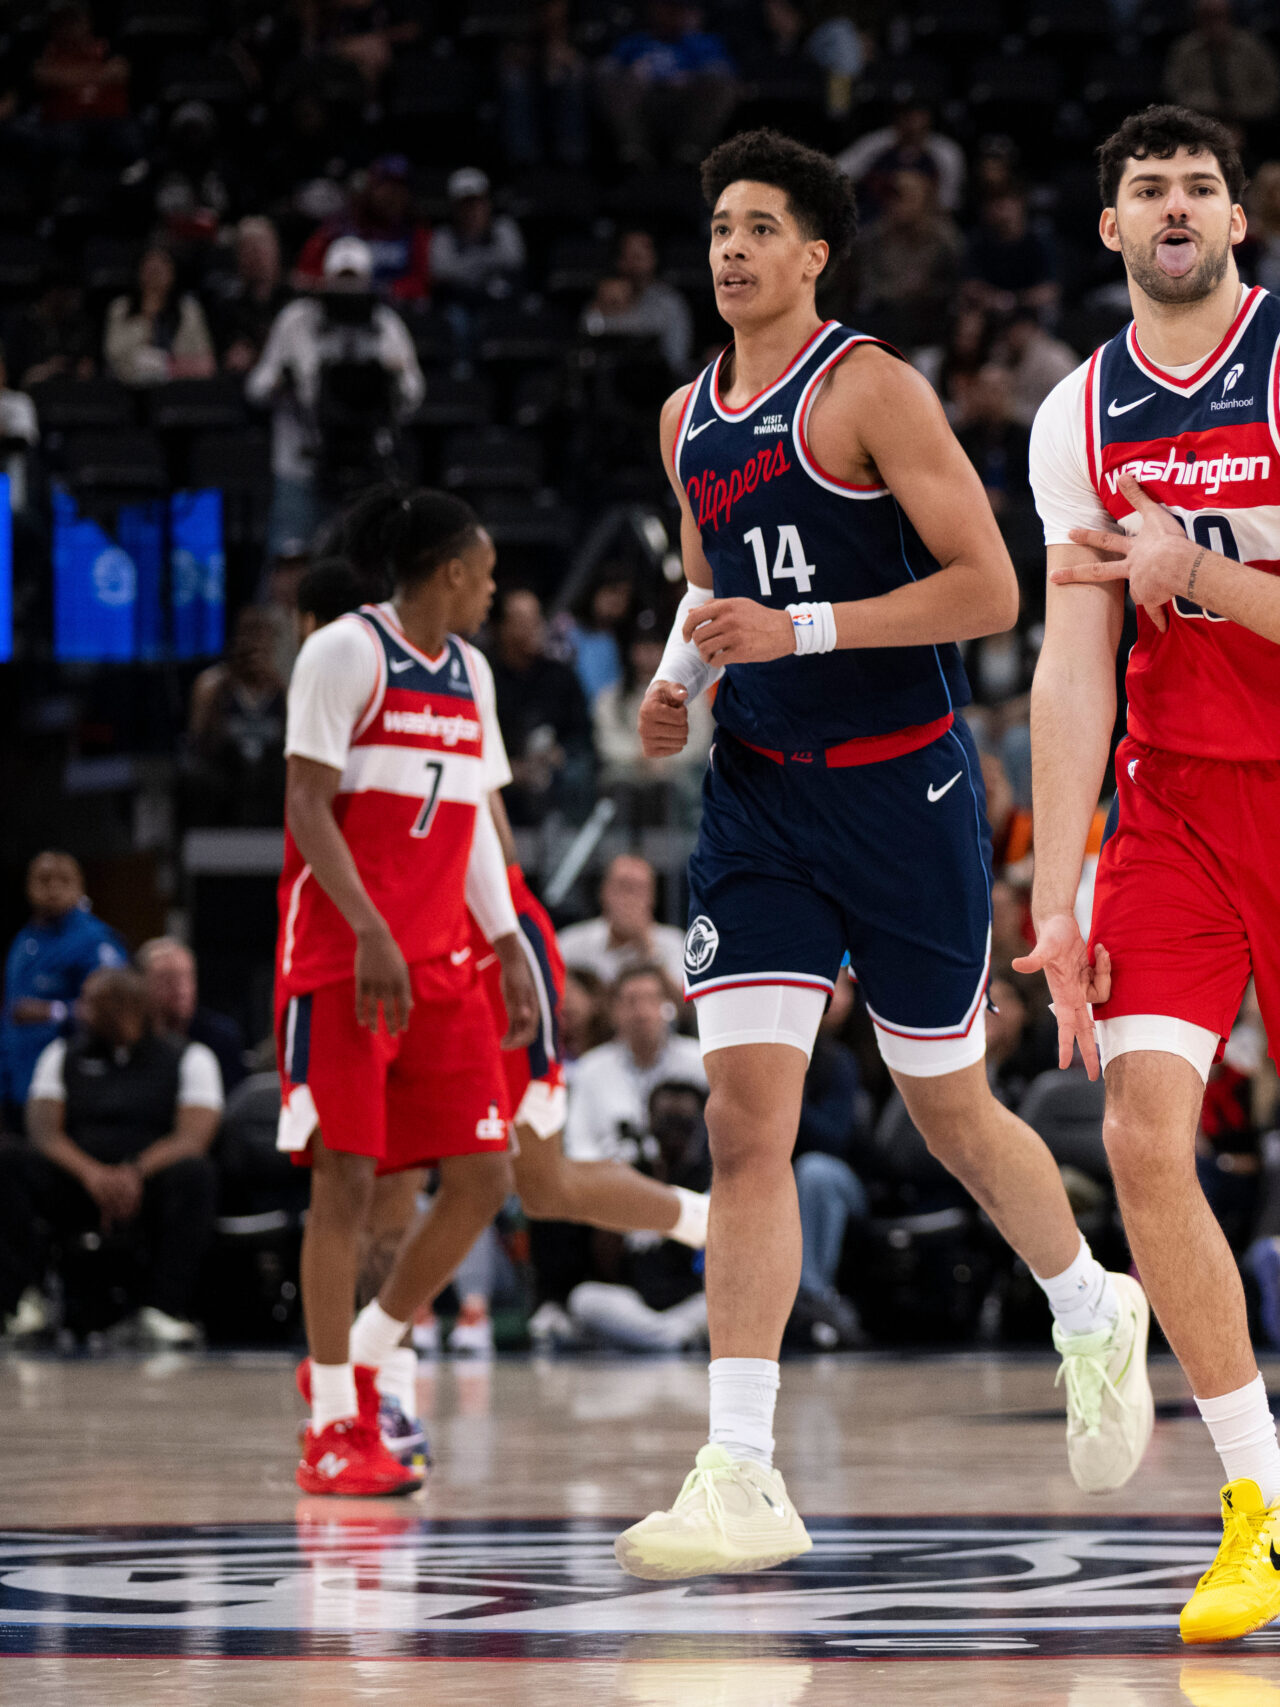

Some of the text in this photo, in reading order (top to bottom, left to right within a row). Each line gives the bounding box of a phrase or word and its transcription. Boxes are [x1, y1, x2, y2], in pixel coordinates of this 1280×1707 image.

[762, 414, 783, 425] VISIT
[1210, 396, 1254, 411] Robinhood
[753, 422, 789, 436] RWANDA
[686, 439, 791, 532] Clippers
[743, 525, 816, 596] 14
[409, 758, 443, 838] 7
